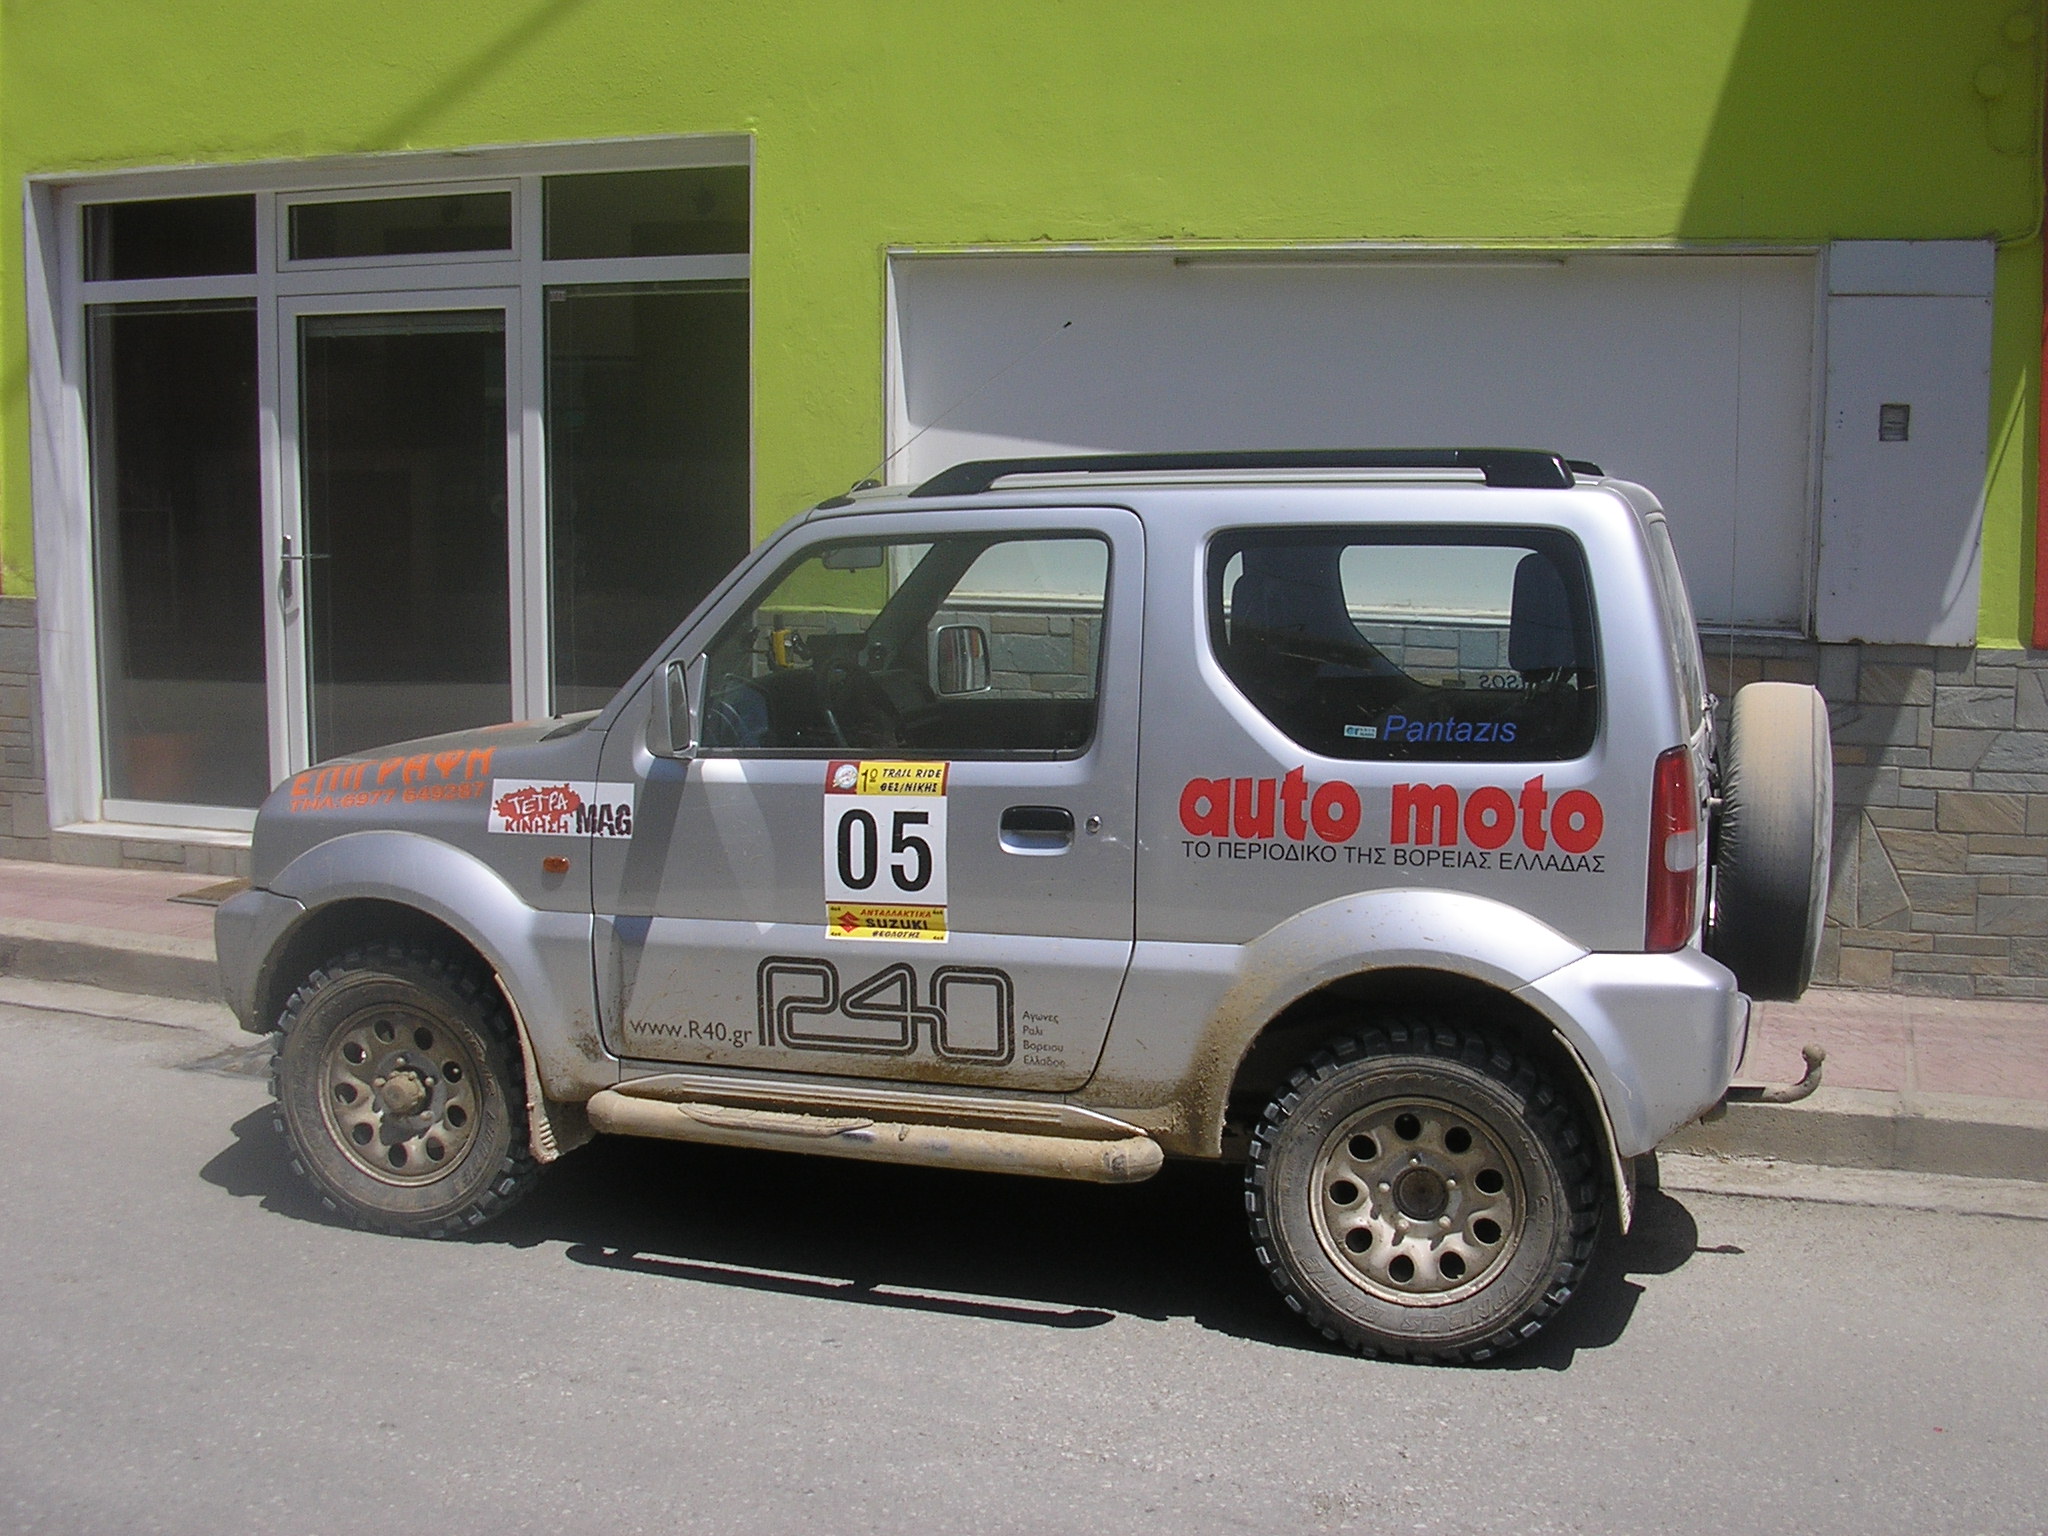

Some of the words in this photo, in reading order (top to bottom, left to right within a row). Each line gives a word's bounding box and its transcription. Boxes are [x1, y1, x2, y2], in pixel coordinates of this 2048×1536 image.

[1382, 714, 1518, 743] Pantazis
[882, 768, 912, 778] TRAIL
[915, 769, 943, 779] RIDE
[880, 782, 938, 793] ΘΕΣ/ΝΙΚΗΣ
[508, 790, 569, 815] ΤΕΤΡΑ
[1178, 765, 1362, 844] auto
[1389, 773, 1604, 854] moto
[504, 819, 569, 834] ΚΙΝΗΣΗ
[574, 802, 631, 837] MAG
[837, 808, 933, 892] 05
[1181, 840, 1211, 859] ΤΟ
[1217, 841, 1337, 864] ΠΕΡΙΟΔΙΚΟ
[1342, 846, 1387, 866] ΤΗΣ
[1394, 848, 1492, 870] ΒΟΡΕΙΑΣ
[1499, 852, 1606, 874] ΕΛΛΑΔΑΣ
[860, 908, 932, 919] ΑΝΤΑΛΛΑΚΤΙΚΑ
[865, 917, 928, 931] SUZUKI
[630, 1020, 752, 1048] www.R40.gr
